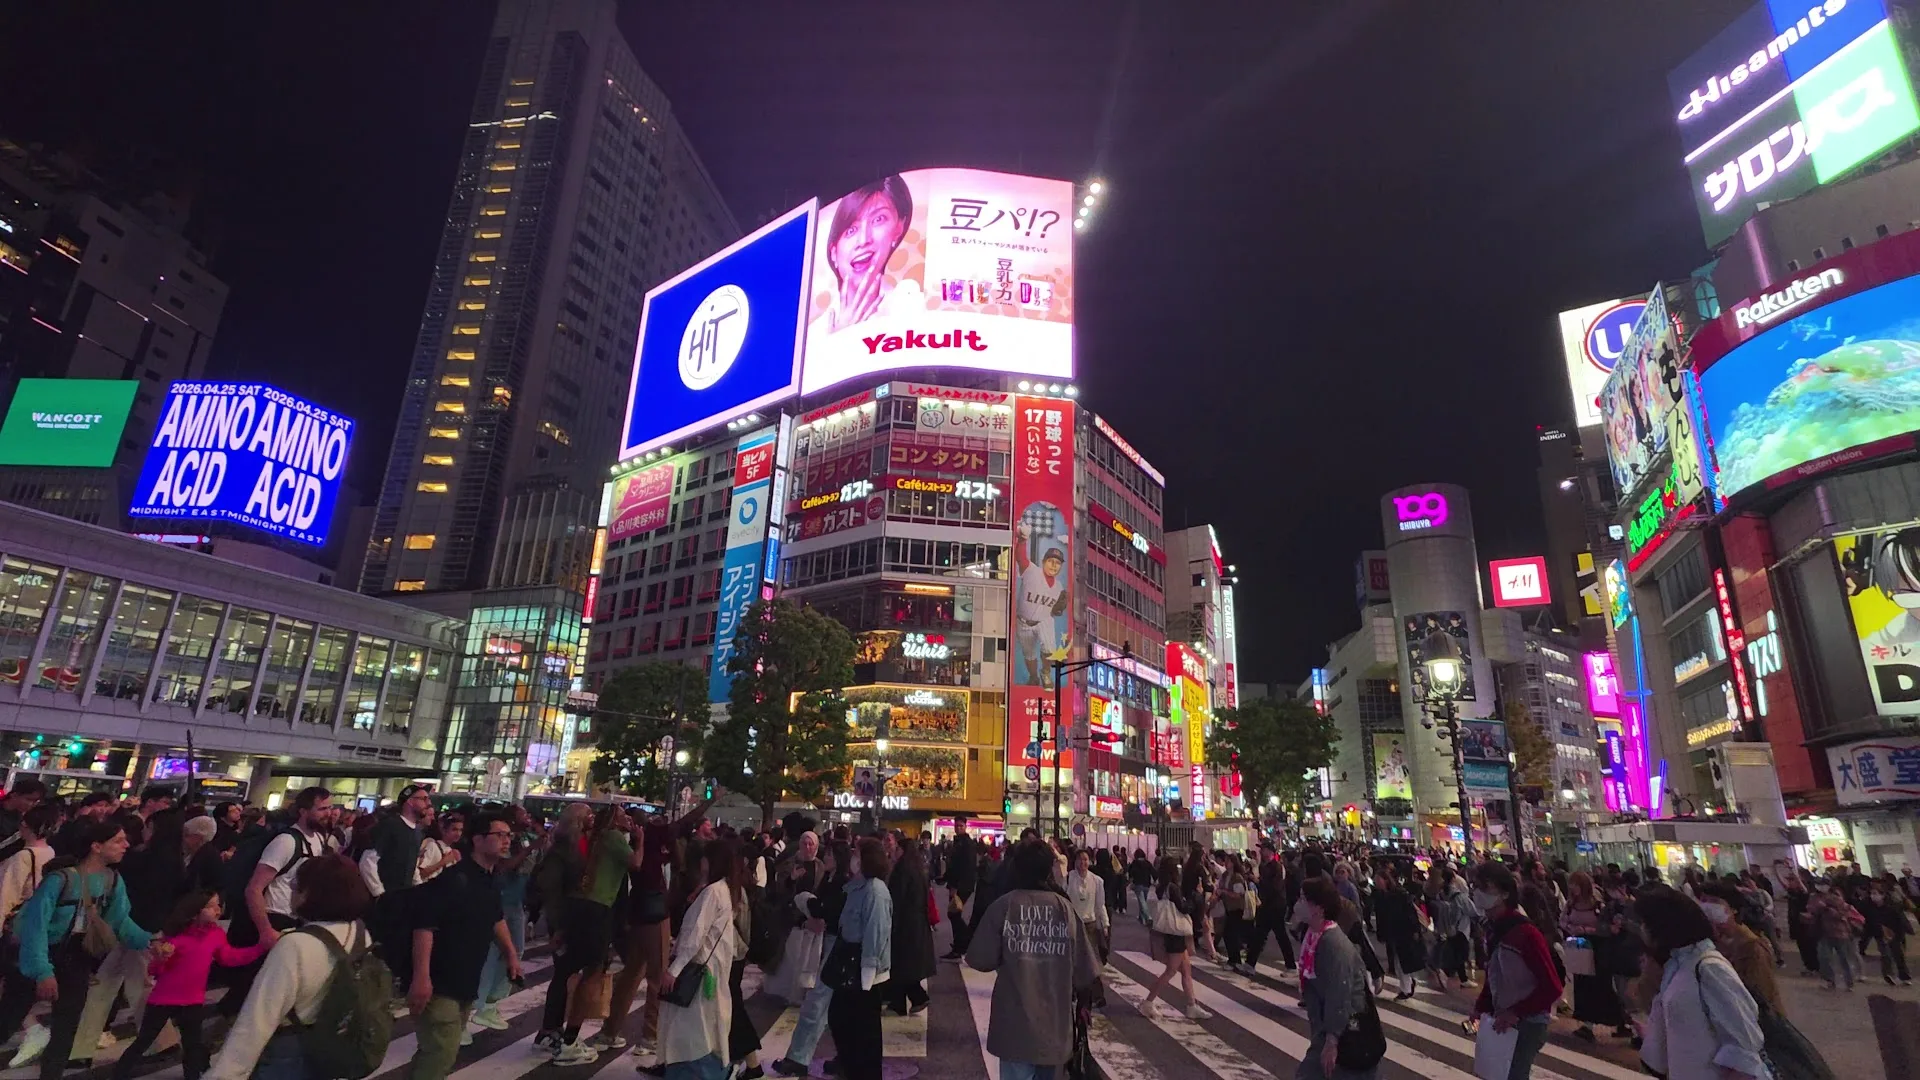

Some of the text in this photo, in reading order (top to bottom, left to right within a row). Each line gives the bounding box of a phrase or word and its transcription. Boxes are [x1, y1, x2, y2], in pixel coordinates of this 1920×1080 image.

[1735, 267, 1845, 329] Rakuten
[862, 329, 988, 355] Yakult
[170, 382, 262, 396] 2026.04.25 SAT
[32, 412, 102, 423] WANCOTT
[263, 388, 352, 430] 2026.04.25 SAT
[950, 409, 1009, 430] しゃぶ葉
[153, 395, 256, 450] AMINO
[249, 401, 347, 481] AMINO
[1045, 410, 1062, 475] 野球って
[742, 450, 767, 468] 当ビル
[891, 447, 985, 470] コンタクト
[147, 450, 227, 507] ACID
[746, 466, 760, 480] 5F
[245, 461, 322, 531] ACID
[840, 479, 874, 502] ガスト
[955, 480, 1001, 500] ガスト
[131, 506, 226, 518] MIDNIGHT EAST
[822, 507, 861, 533] ガスト
[1393, 492, 1448, 526] 109
[227, 510, 323, 544] MIDNIGHT EAST
[1400, 519, 1431, 530] SHIBUYA
[1224, 604, 1233, 639] CAMERA
[1747, 631, 1782, 679] クスリ
[1020, 905, 1053, 921] LOVE
[1002, 920, 1070, 938] Psychedelic
[1007, 938, 1066, 955] Orchestra
